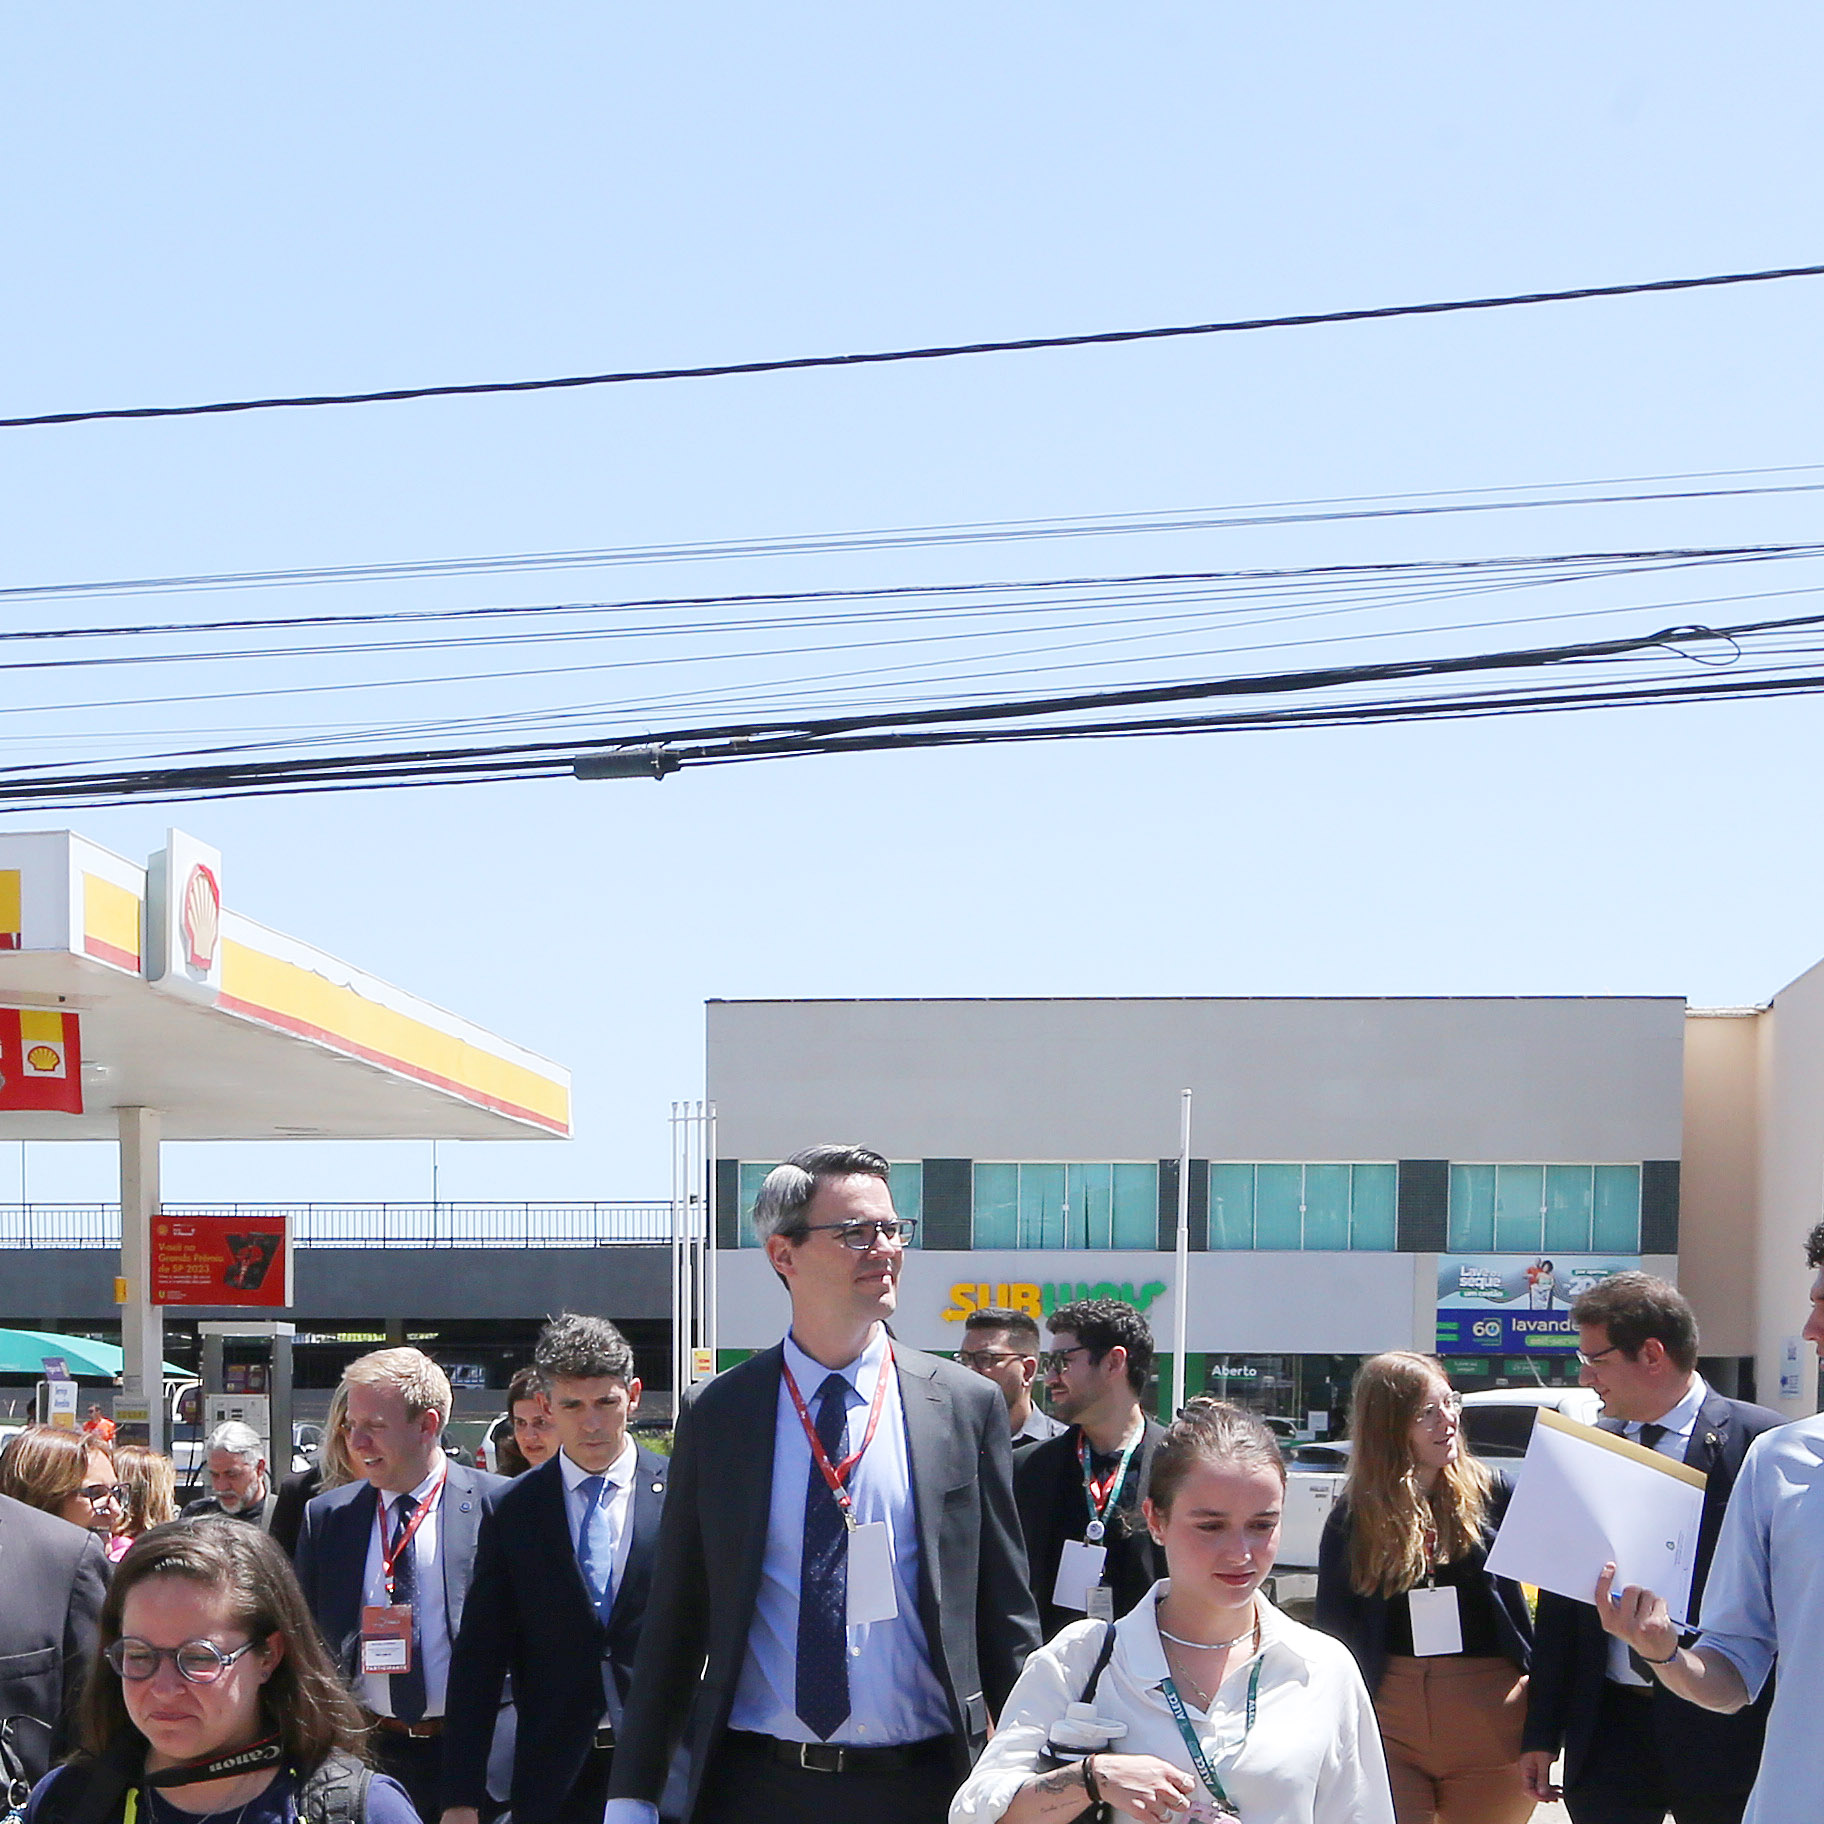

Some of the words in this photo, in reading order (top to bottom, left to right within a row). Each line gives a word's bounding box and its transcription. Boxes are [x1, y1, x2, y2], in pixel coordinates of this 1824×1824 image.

[1459, 1276, 1502, 1289] seque
[1512, 1318, 1581, 1332] lavande
[1211, 1365, 1257, 1377] Aberto
[209, 1746, 281, 1773] Canon
